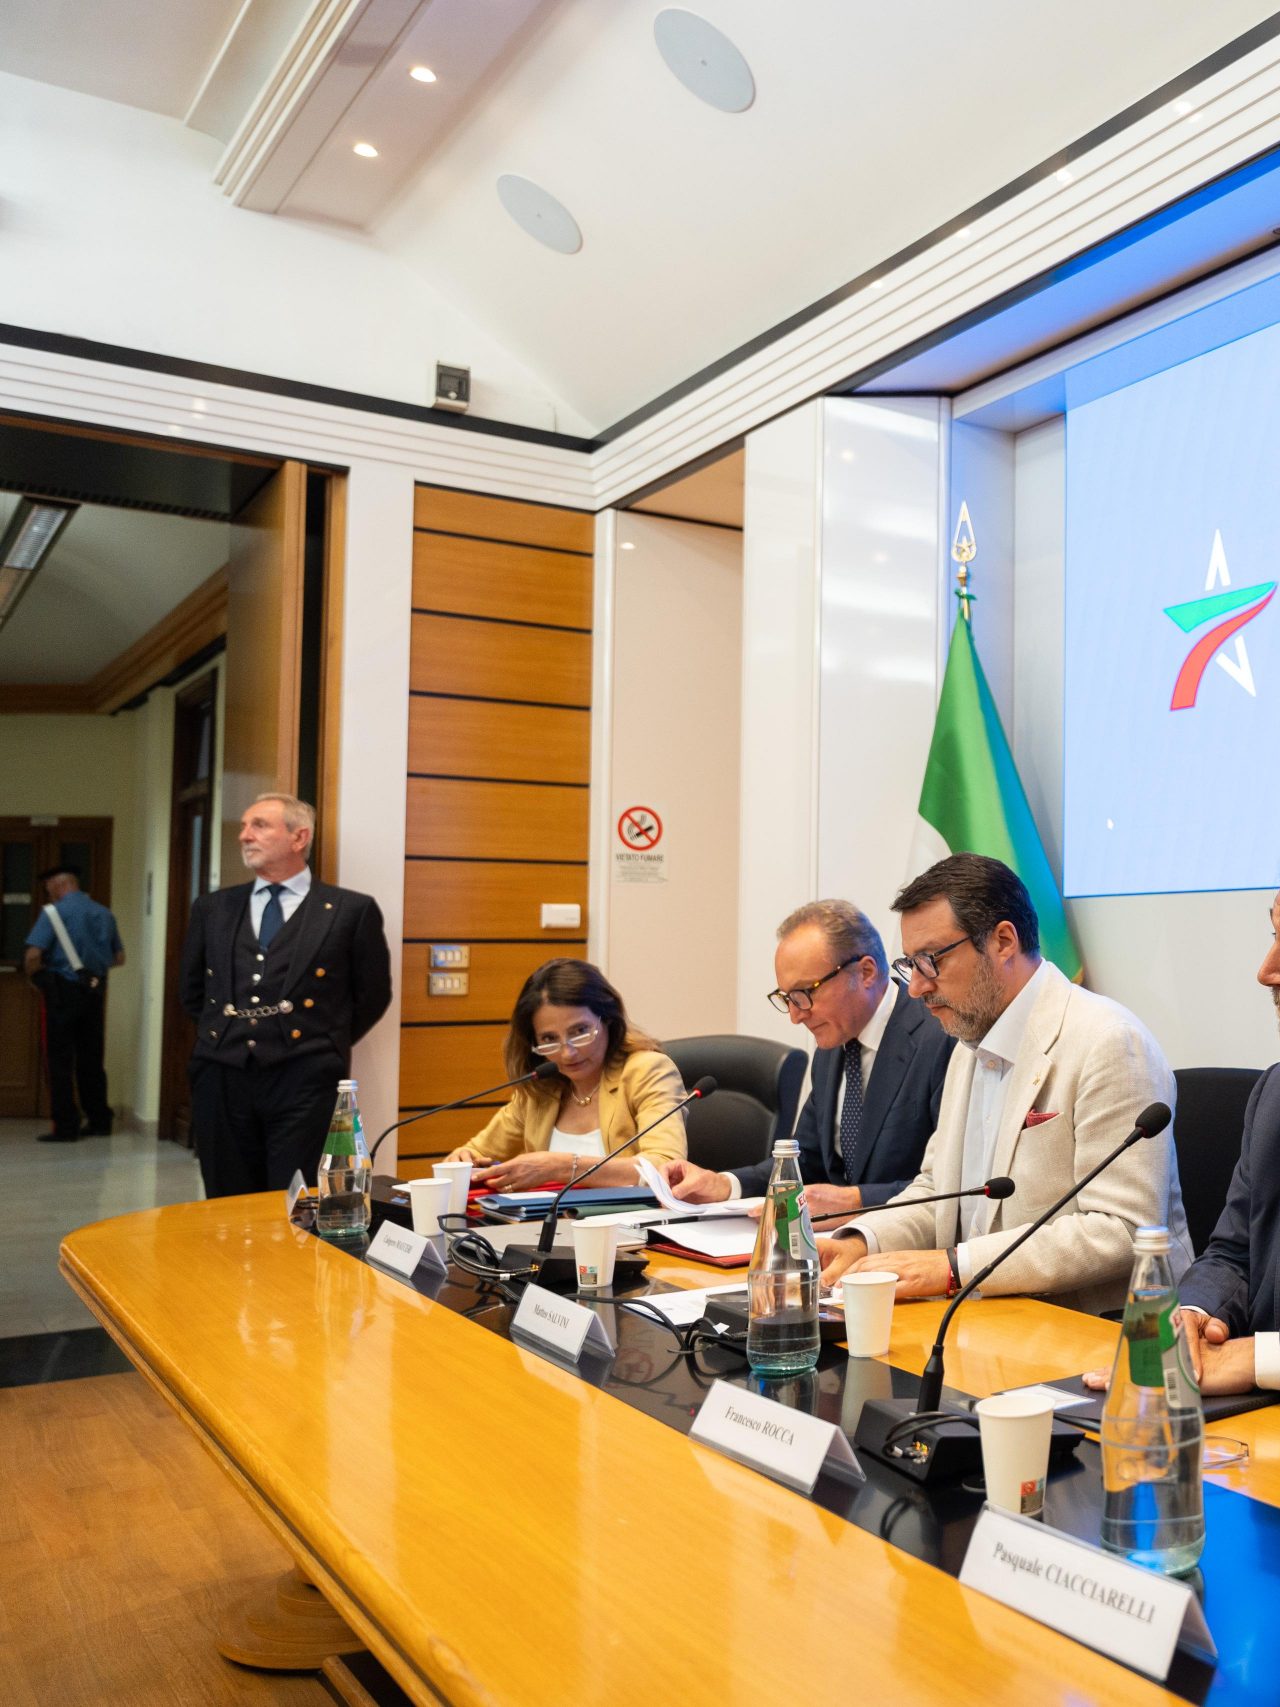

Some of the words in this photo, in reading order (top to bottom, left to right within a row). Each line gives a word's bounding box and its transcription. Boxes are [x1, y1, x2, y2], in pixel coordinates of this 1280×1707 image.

[724, 1405, 762, 1433] Francesco
[761, 1420, 795, 1447] ROCCA
[992, 1541, 1043, 1577] Pasquale
[1045, 1563, 1156, 1626] CIACCIARELLI
